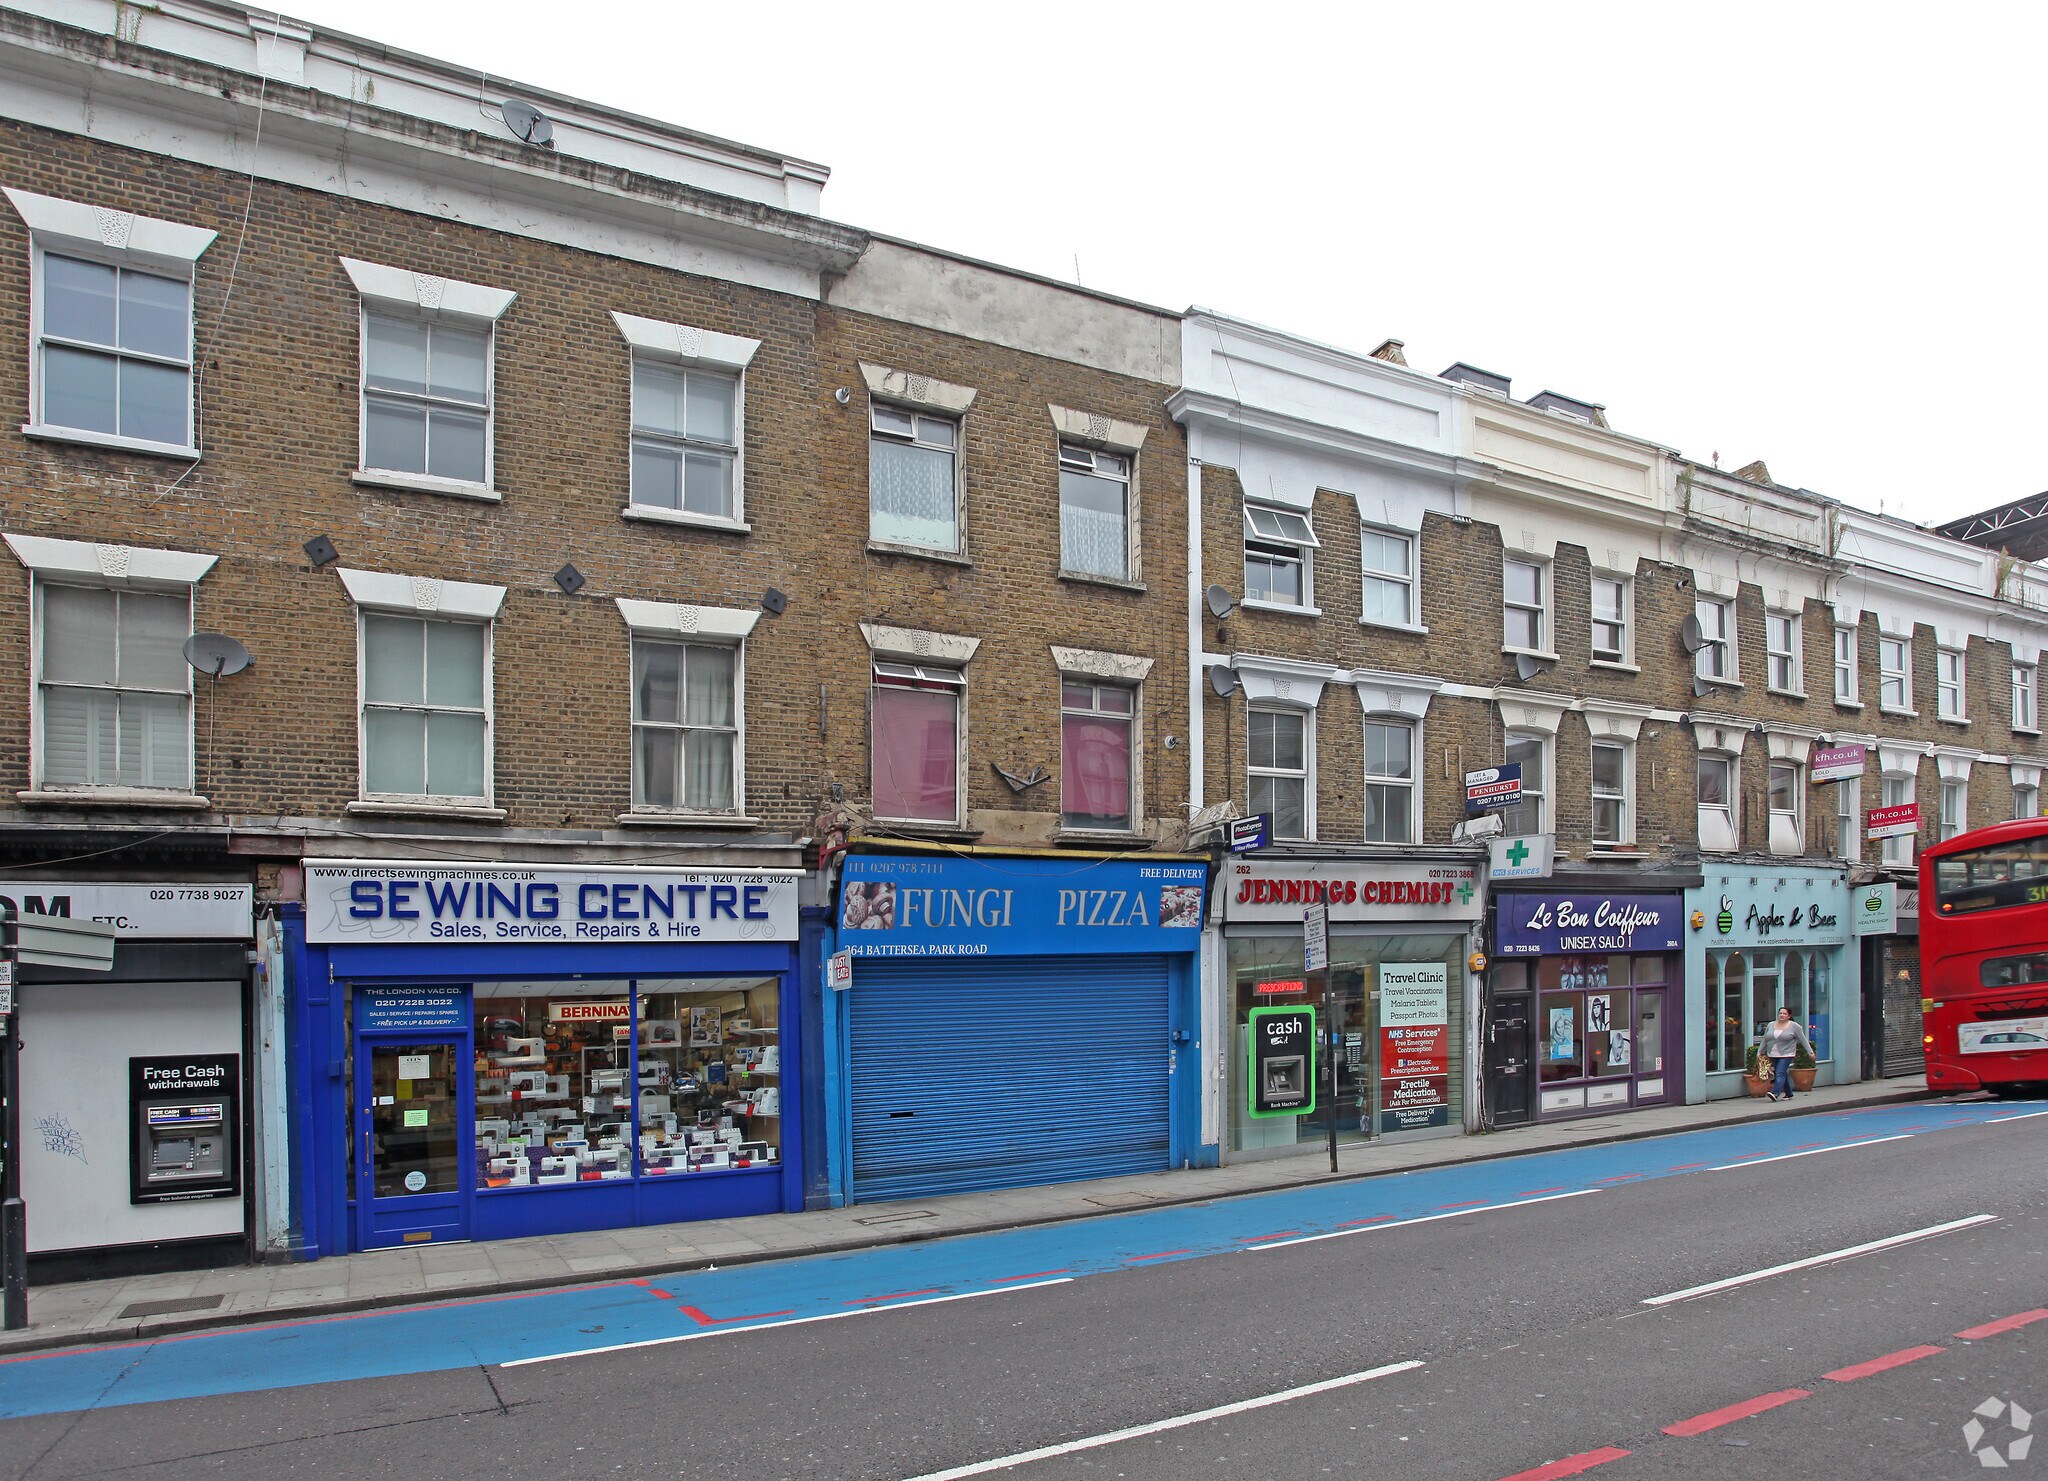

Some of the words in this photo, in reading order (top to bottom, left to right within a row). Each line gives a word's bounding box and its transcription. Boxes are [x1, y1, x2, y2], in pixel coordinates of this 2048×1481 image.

[1815, 749, 1859, 762] kfh.co.uk
[1467, 776, 1493, 784] MANAGED
[1474, 783, 1513, 795] PENHURST
[1505, 792, 1520, 800] 0100
[1871, 807, 1913, 821] kfh.co.uk
[871, 862, 896, 873] 0207
[900, 863, 918, 874] 978
[1140, 868, 1161, 878] FREE
[1162, 868, 1204, 879] DELIVERY
[1236, 865, 1250, 874] 262
[1429, 870, 1440, 878] 020
[1442, 870, 1458, 878] 7223
[1507, 868, 1540, 876] SERVICES
[314, 868, 536, 881] www.directsewingmachines.co.uk
[684, 874, 700, 883] Tel
[713, 874, 733, 883] 020
[737, 875, 763, 884] 7228
[767, 875, 793, 884] 3022
[150, 890, 174, 900] 020
[178, 890, 210, 900] 7738
[213, 890, 244, 900] 9027
[1238, 879, 1357, 903] JENNINGS
[1363, 880, 1454, 904] CHEMIST
[350, 880, 559, 919] SEWING
[578, 883, 769, 920] CENTRE
[900, 888, 1014, 928] FUNGI
[1056, 889, 1150, 926] PIZZA
[1526, 902, 1552, 930] Le
[1556, 901, 1590, 928] Bon
[1594, 900, 1660, 935] Coiffeur
[1746, 903, 1785, 935] Apples
[1788, 906, 1804, 928] &
[1807, 903, 1837, 929] Bees
[430, 921, 487, 940] Sales,
[496, 921, 567, 939] Service,
[576, 922, 640, 941] Repairs
[648, 922, 660, 937] &
[668, 922, 701, 937] Hire
[1560, 936, 1597, 950] UNISEX
[1598, 935, 1632, 949] SALO
[1725, 938, 1736, 946] shop
[866, 945, 926, 955] BATTERSEA
[929, 944, 957, 955] PARK
[958, 944, 988, 954] ROAD
[835, 956, 846, 968] JUST
[1384, 972, 1416, 983] Travel
[1417, 971, 1443, 983] Clinic
[1257, 981, 1304, 993] PRESCRIPTIONS
[1405, 987, 1443, 995] Vaccinations
[561, 1005, 630, 1018] BERNINA
[1390, 1011, 1417, 1020] Passport
[1267, 1017, 1302, 1035] cash
[1388, 1030, 1404, 1038] NHS
[143, 1067, 180, 1080] Free
[185, 1065, 225, 1078] Cash
[148, 1078, 220, 1090] withdrawals
[1400, 1079, 1430, 1089] Erectile
[1393, 1088, 1436, 1099] Medication
[1411, 1096, 1441, 1104] Pharmacist)
